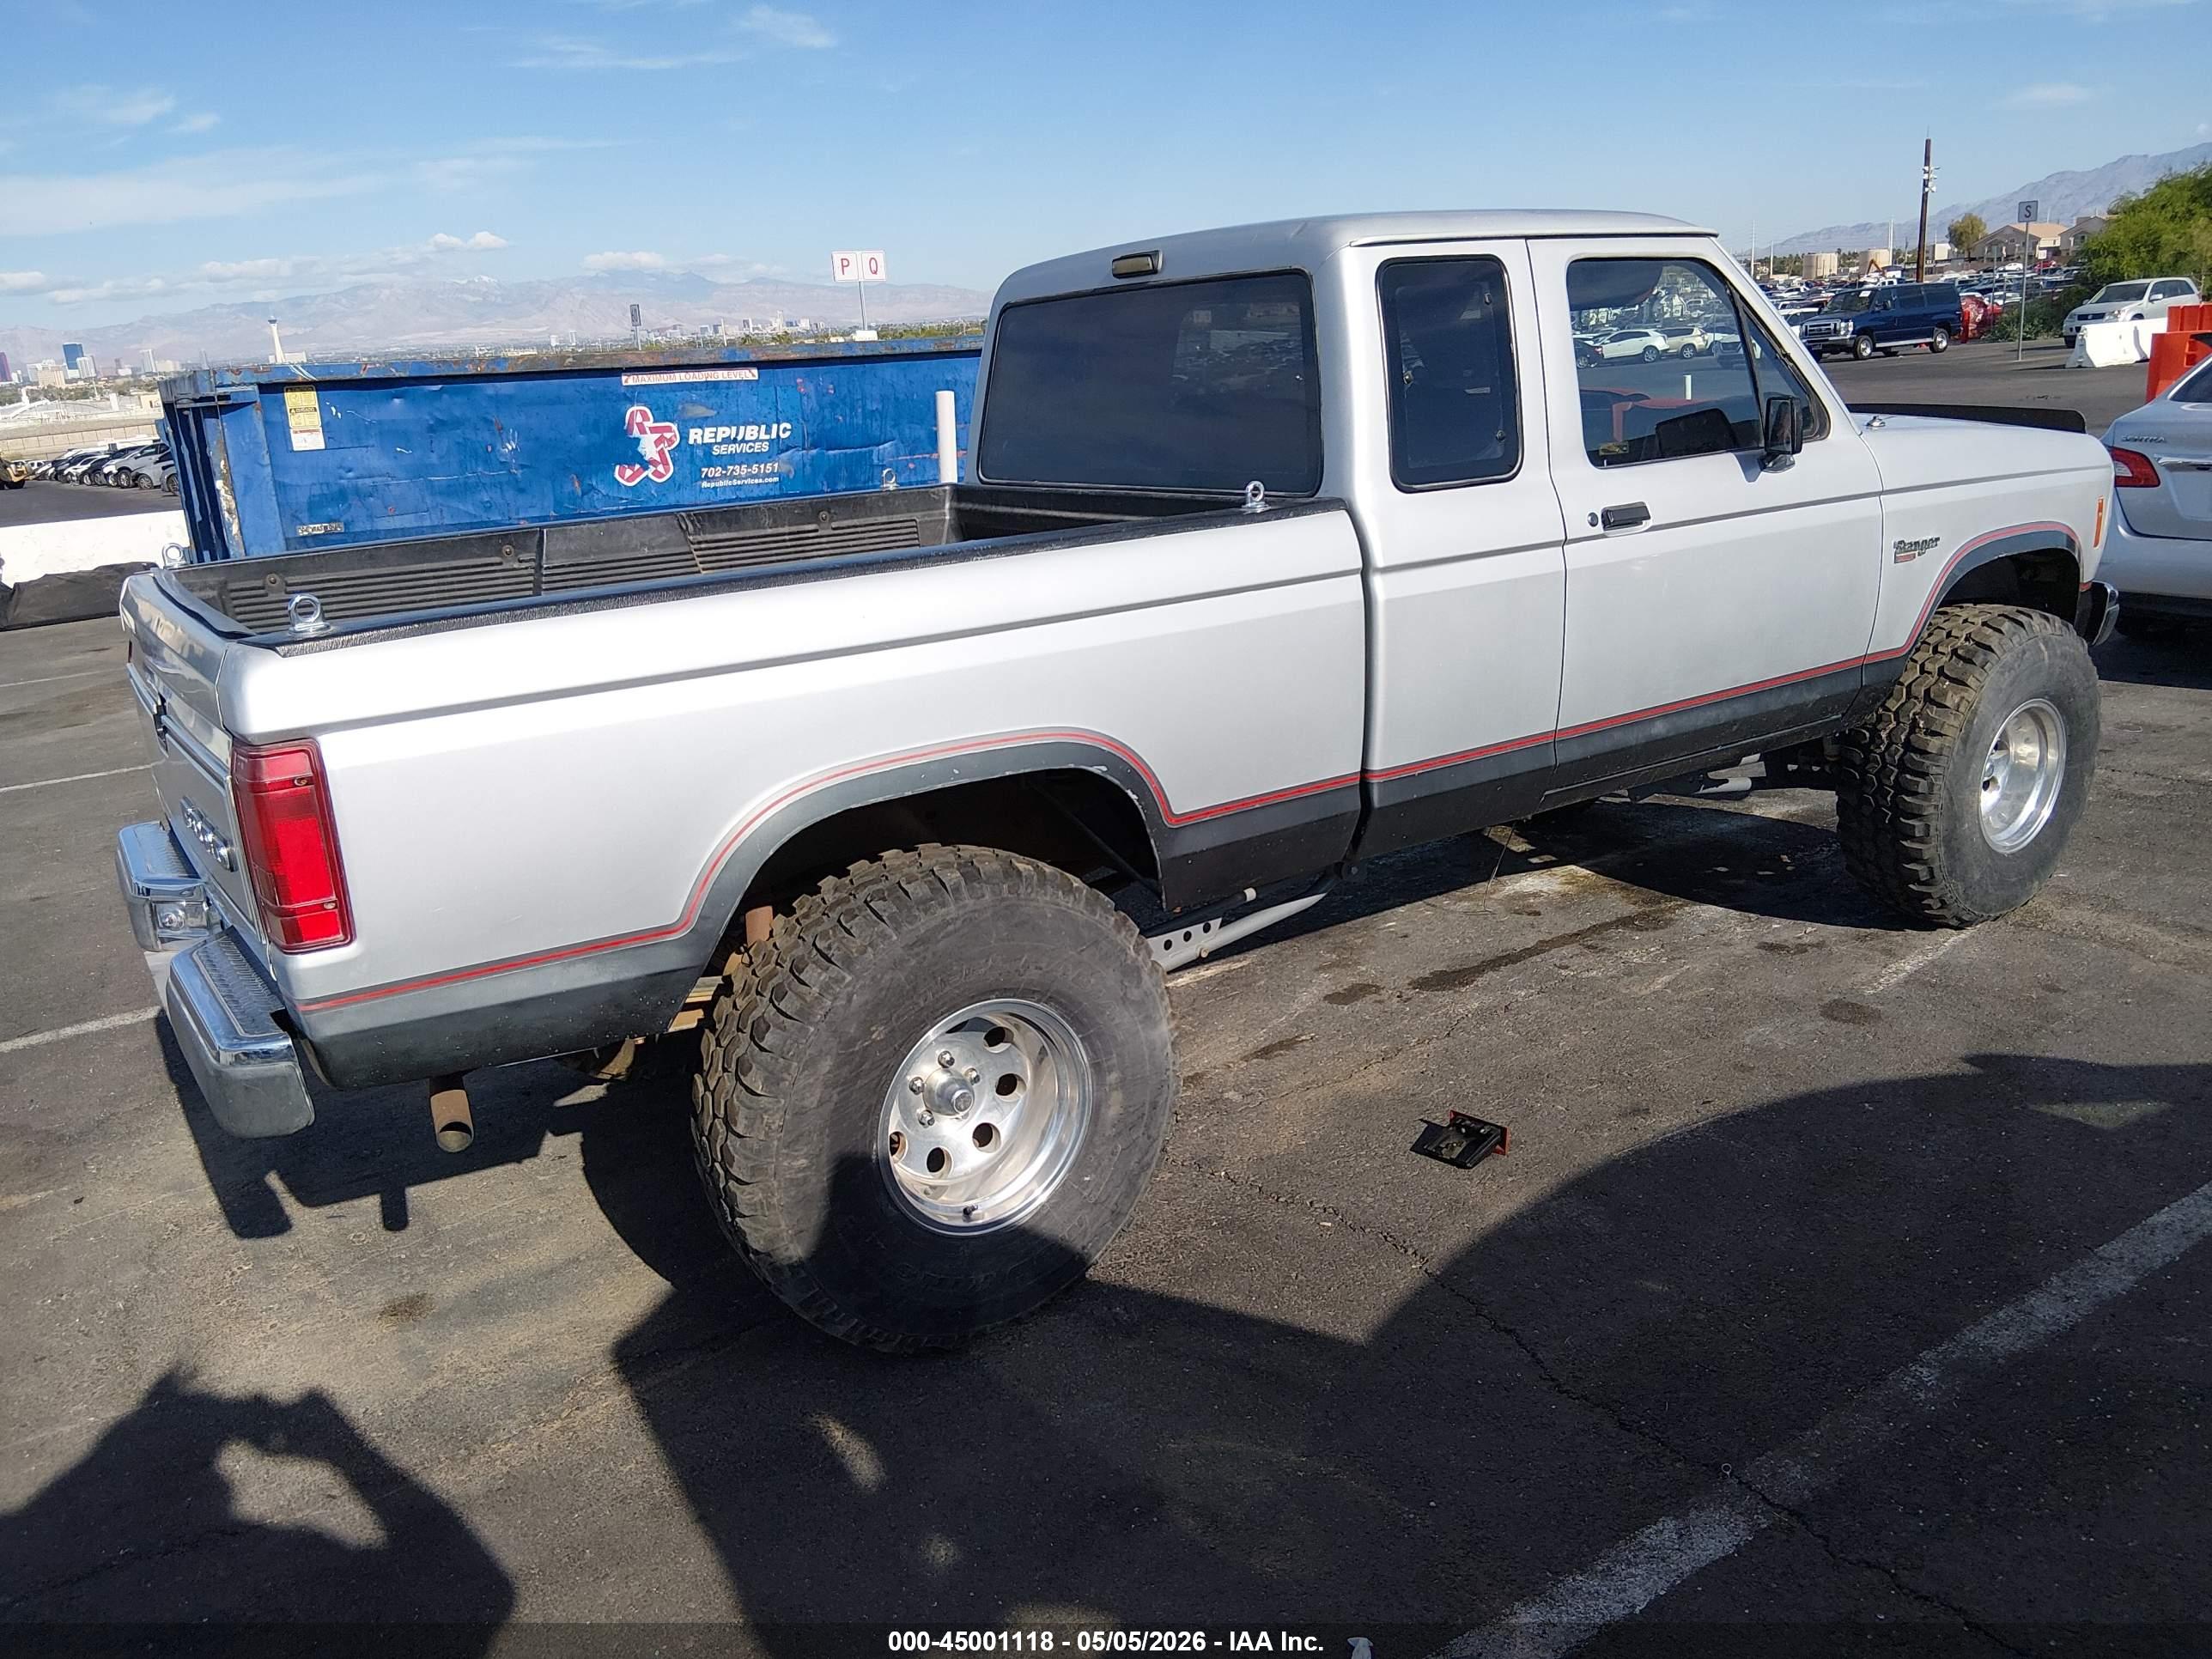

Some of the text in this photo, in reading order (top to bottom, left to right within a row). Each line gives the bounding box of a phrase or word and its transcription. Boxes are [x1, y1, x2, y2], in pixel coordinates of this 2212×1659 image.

[2024, 205, 2032, 218] S
[841, 258, 850, 275] P
[869, 257, 878, 275] Q
[632, 371, 750, 384] MAXIMUM LOADING LEVEL
[688, 422, 792, 445] REPUBLIC
[712, 441, 769, 456] SERVICES
[701, 462, 779, 478] 702-735-5151
[702, 477, 780, 489] RepublicServices.com
[1893, 537, 1941, 557] Ranger
